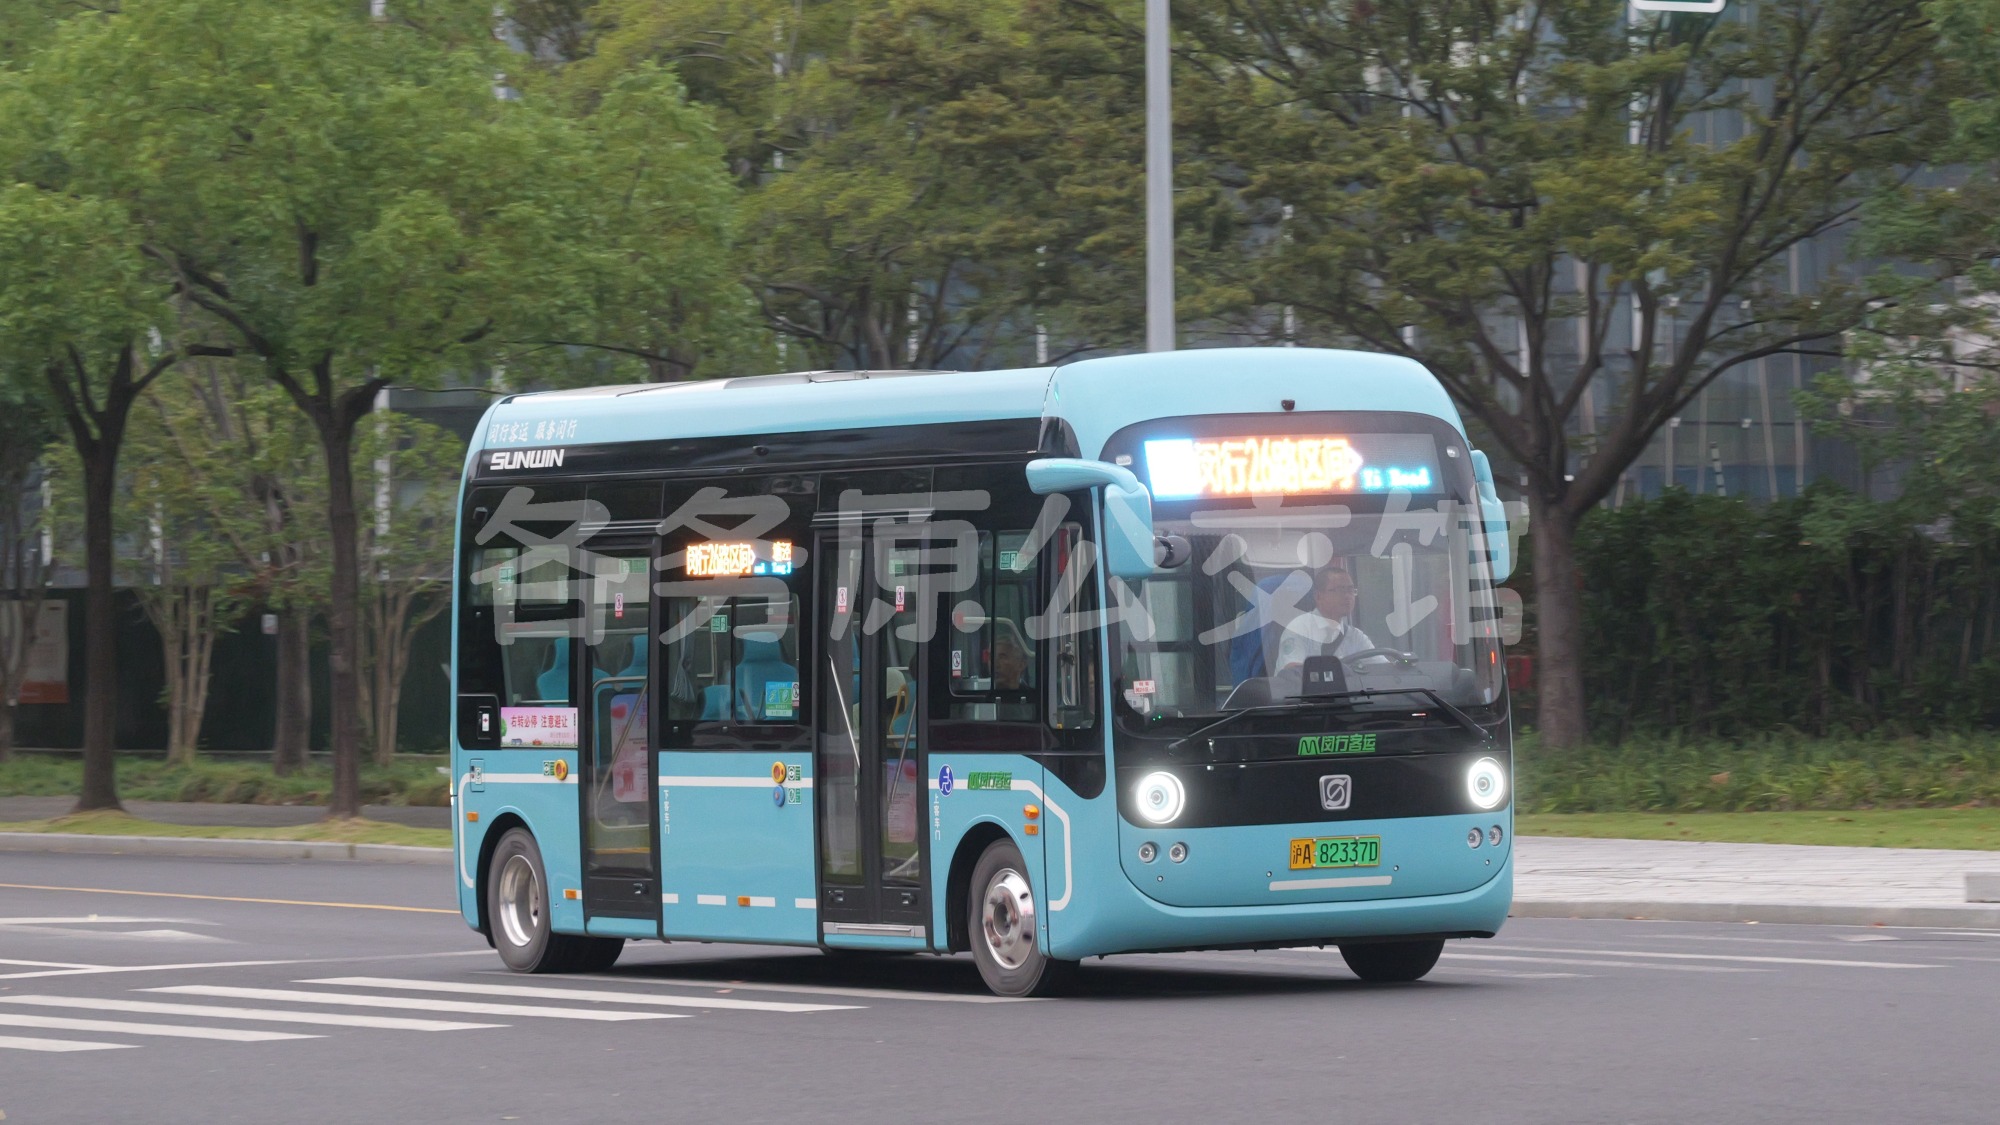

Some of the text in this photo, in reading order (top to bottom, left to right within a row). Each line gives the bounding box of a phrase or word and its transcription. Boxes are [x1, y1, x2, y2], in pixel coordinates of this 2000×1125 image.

[490, 449, 565, 471] SUNWIN
[511, 715, 538, 728] 右转必停
[541, 714, 568, 729] 注意避让
[1320, 733, 1377, 753] 闵行客运
